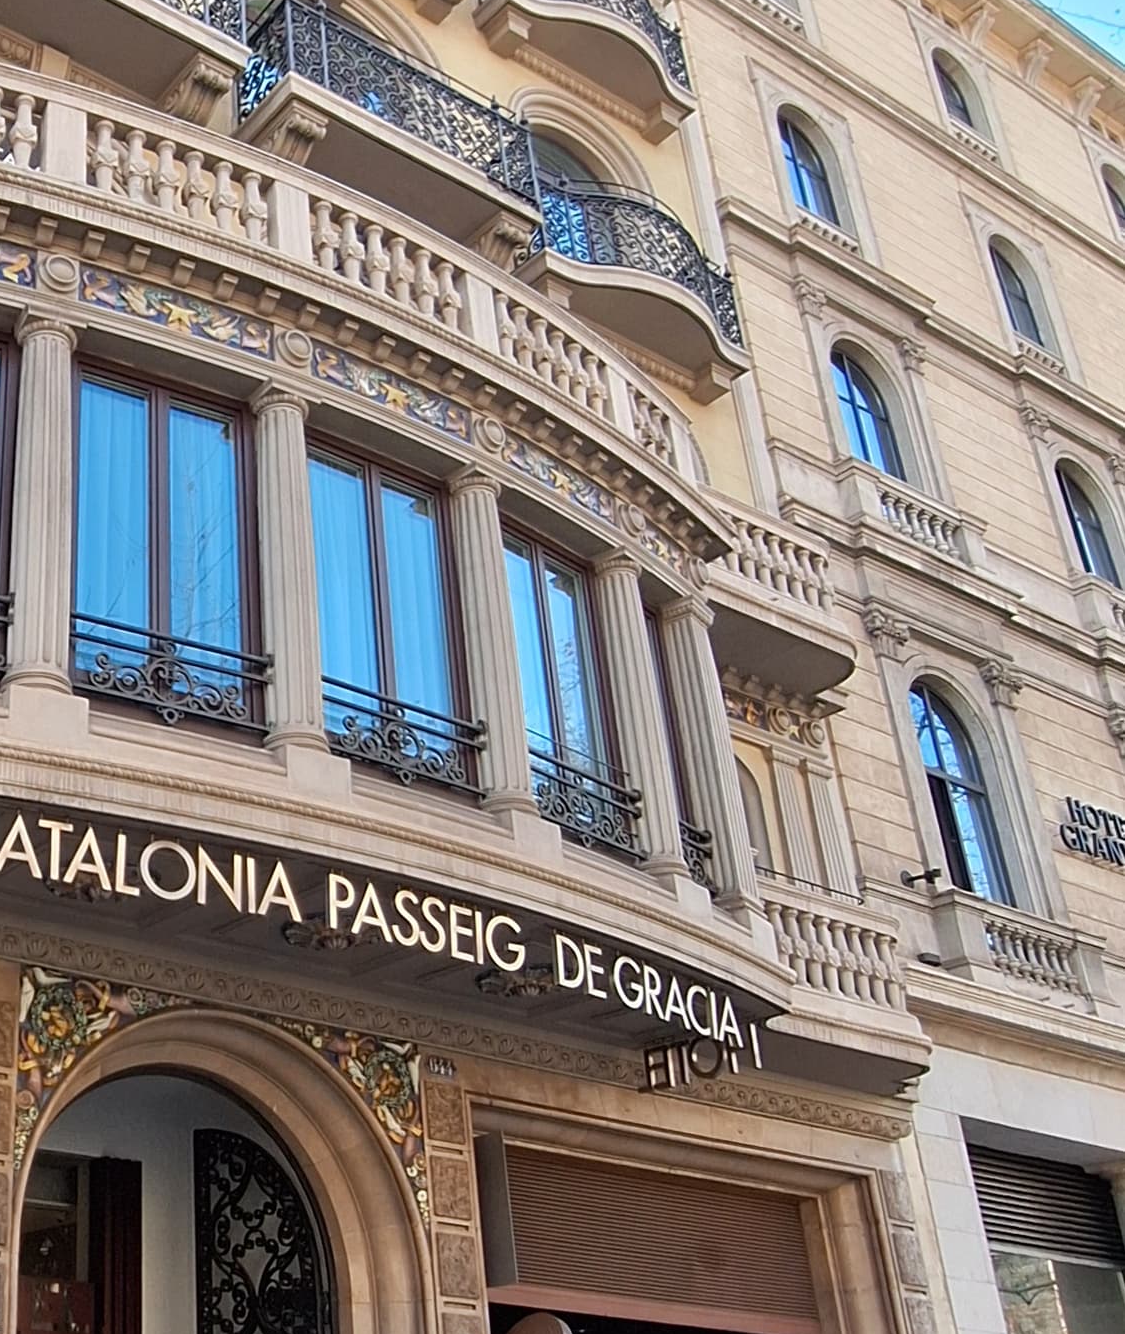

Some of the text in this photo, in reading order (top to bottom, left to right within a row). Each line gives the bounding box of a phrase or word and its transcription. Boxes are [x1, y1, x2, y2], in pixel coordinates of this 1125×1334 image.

[328, 873, 527, 972] PASSEIG
[555, 933, 608, 1000] DE
[613, 954, 744, 1049] GRACIA
